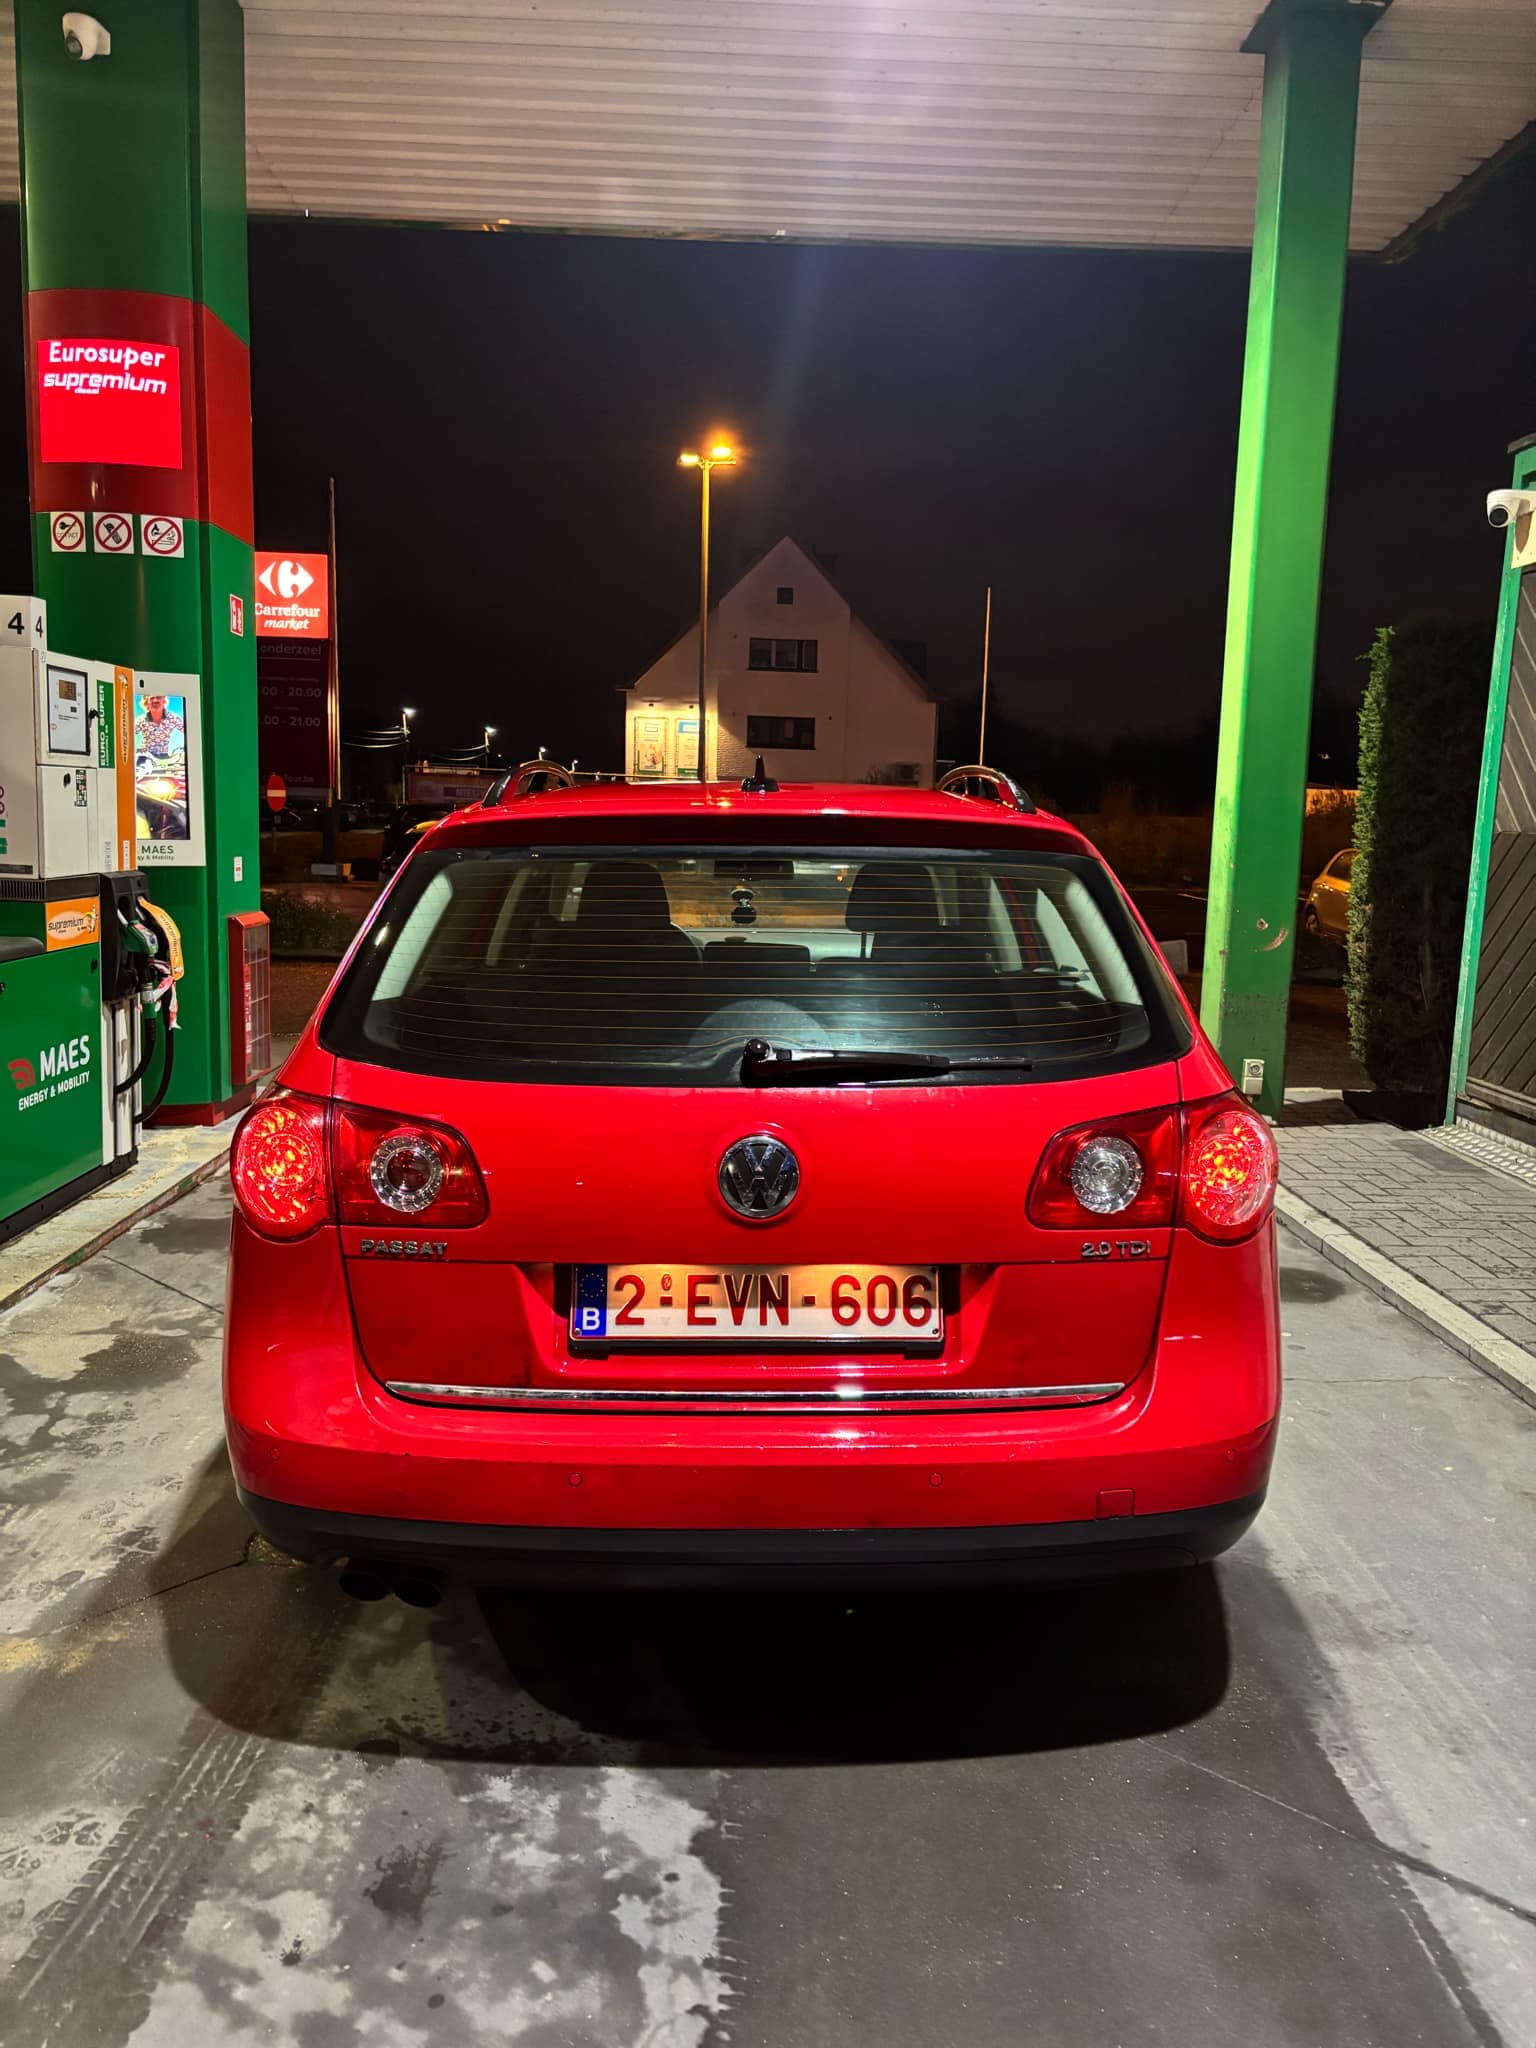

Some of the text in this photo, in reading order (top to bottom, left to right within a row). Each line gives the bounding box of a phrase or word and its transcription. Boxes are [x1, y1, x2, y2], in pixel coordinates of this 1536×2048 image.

[49, 341, 165, 370] Eurosuper
[44, 371, 167, 395] supremium
[254, 602, 320, 617] Carrefour
[8, 612, 24, 635] 4
[36, 615, 43, 639] 4
[264, 618, 310, 630] market
[257, 643, 321, 655] onderzeel
[141, 845, 174, 854] MAES
[40, 1035, 90, 1081] MAES
[18, 1071, 90, 1112] ENERGY & MOBILITY
[360, 1240, 448, 1256] PASSAT
[1081, 1240, 1151, 1256] 2.0 TDI
[582, 1307, 600, 1330] B
